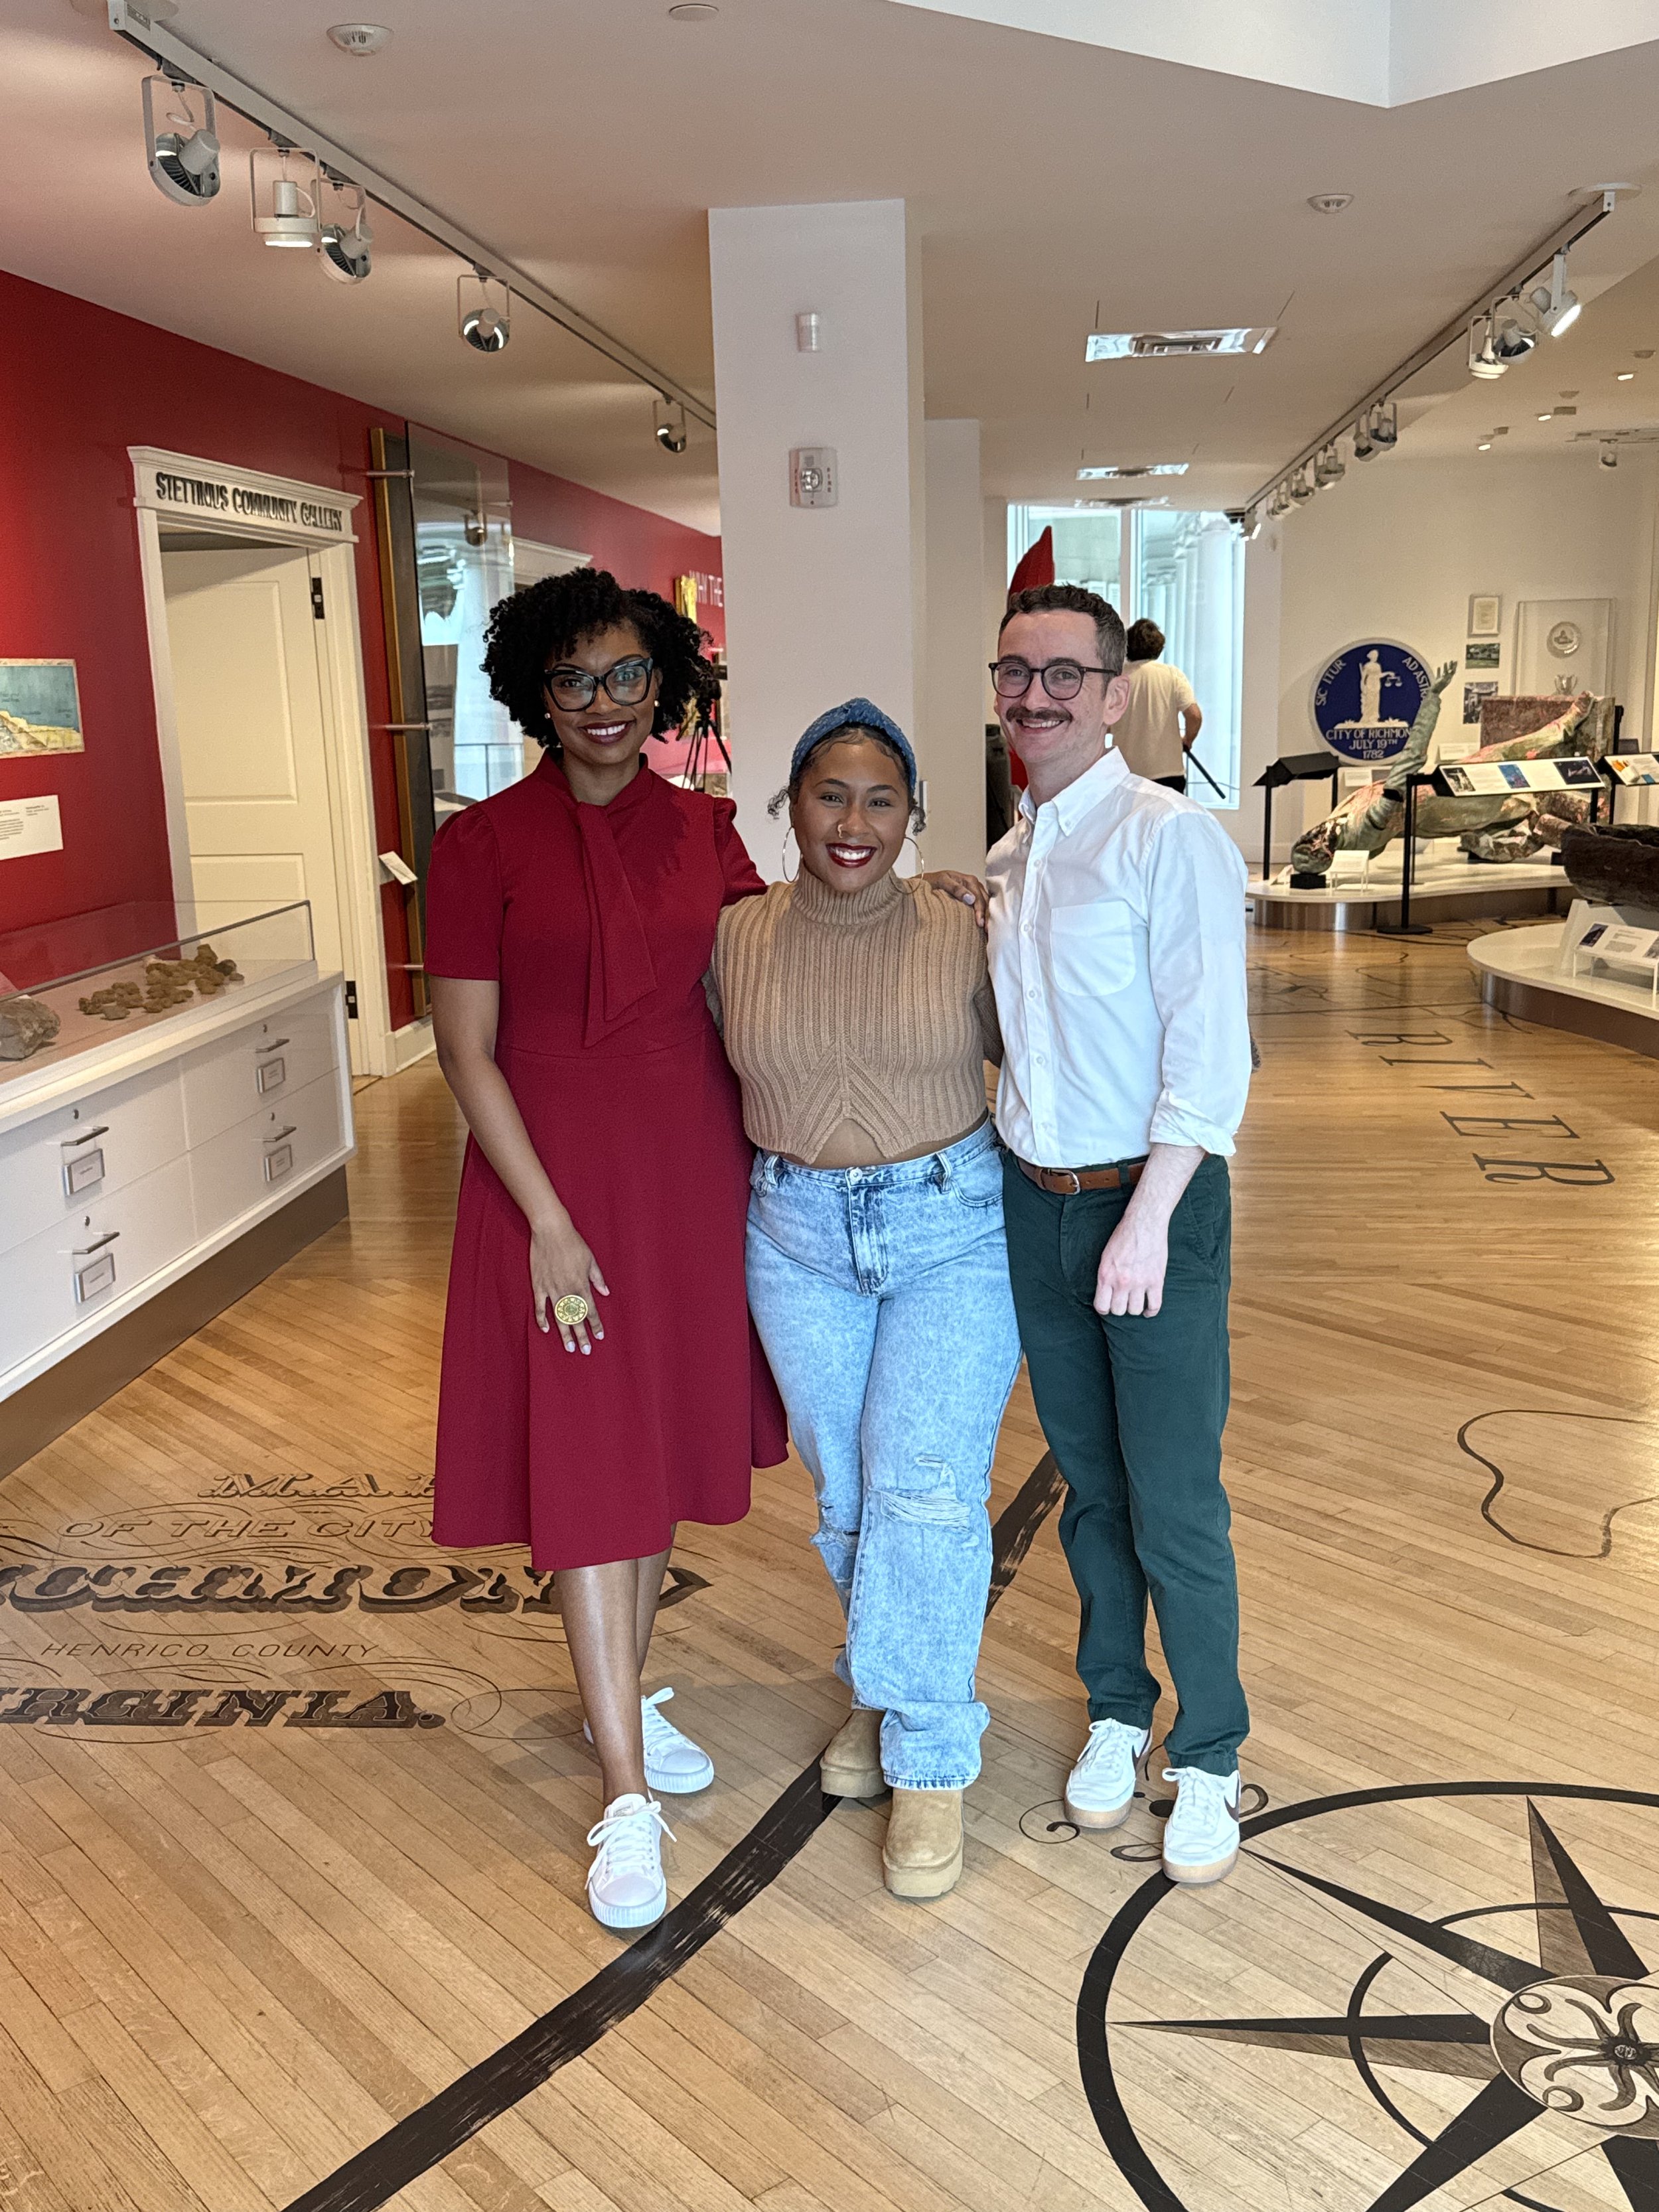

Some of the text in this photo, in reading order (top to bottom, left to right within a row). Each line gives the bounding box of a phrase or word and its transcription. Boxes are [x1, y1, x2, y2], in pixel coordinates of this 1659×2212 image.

[156, 472, 342, 531] STETTINIUS COMMUNITY GALLERY
[1315, 659, 1346, 706] SIC ITUR
[1402, 656, 1429, 702] AD ASTR
[1325, 728, 1412, 741] CITY OF RICHMON
[1348, 738, 1398, 750] JULY 19TH
[1362, 749, 1384, 759] 1782
[57, 1519, 153, 1538] OF
[171, 1519, 296, 1538] THE
[40, 1643, 379, 1658] HENRICO COUNTY
